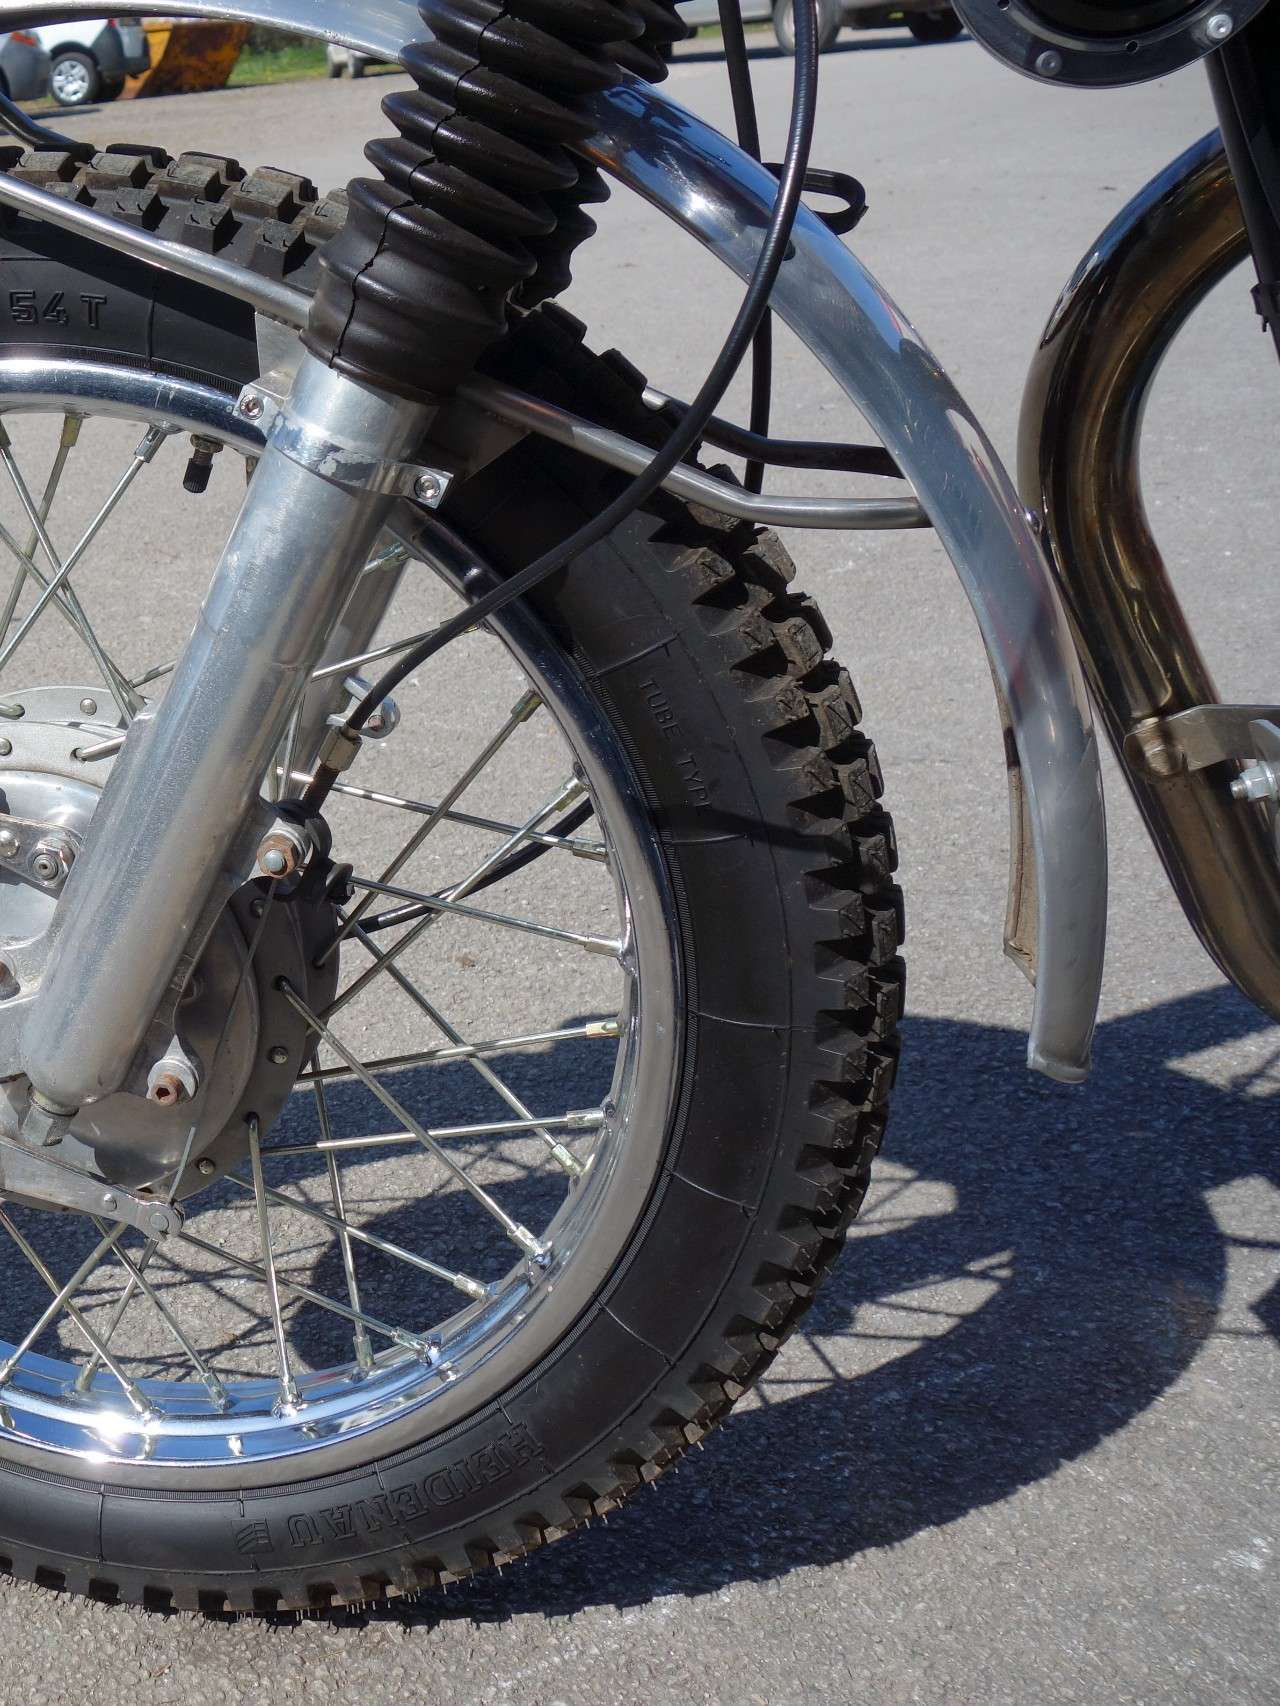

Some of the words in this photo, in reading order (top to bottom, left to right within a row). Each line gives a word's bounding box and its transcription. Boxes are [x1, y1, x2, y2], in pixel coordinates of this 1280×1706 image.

[8, 289, 70, 326] 54
[79, 291, 108, 330] T
[639, 678, 683, 738] TUBE
[286, 1420, 546, 1549] HEIDENAU
